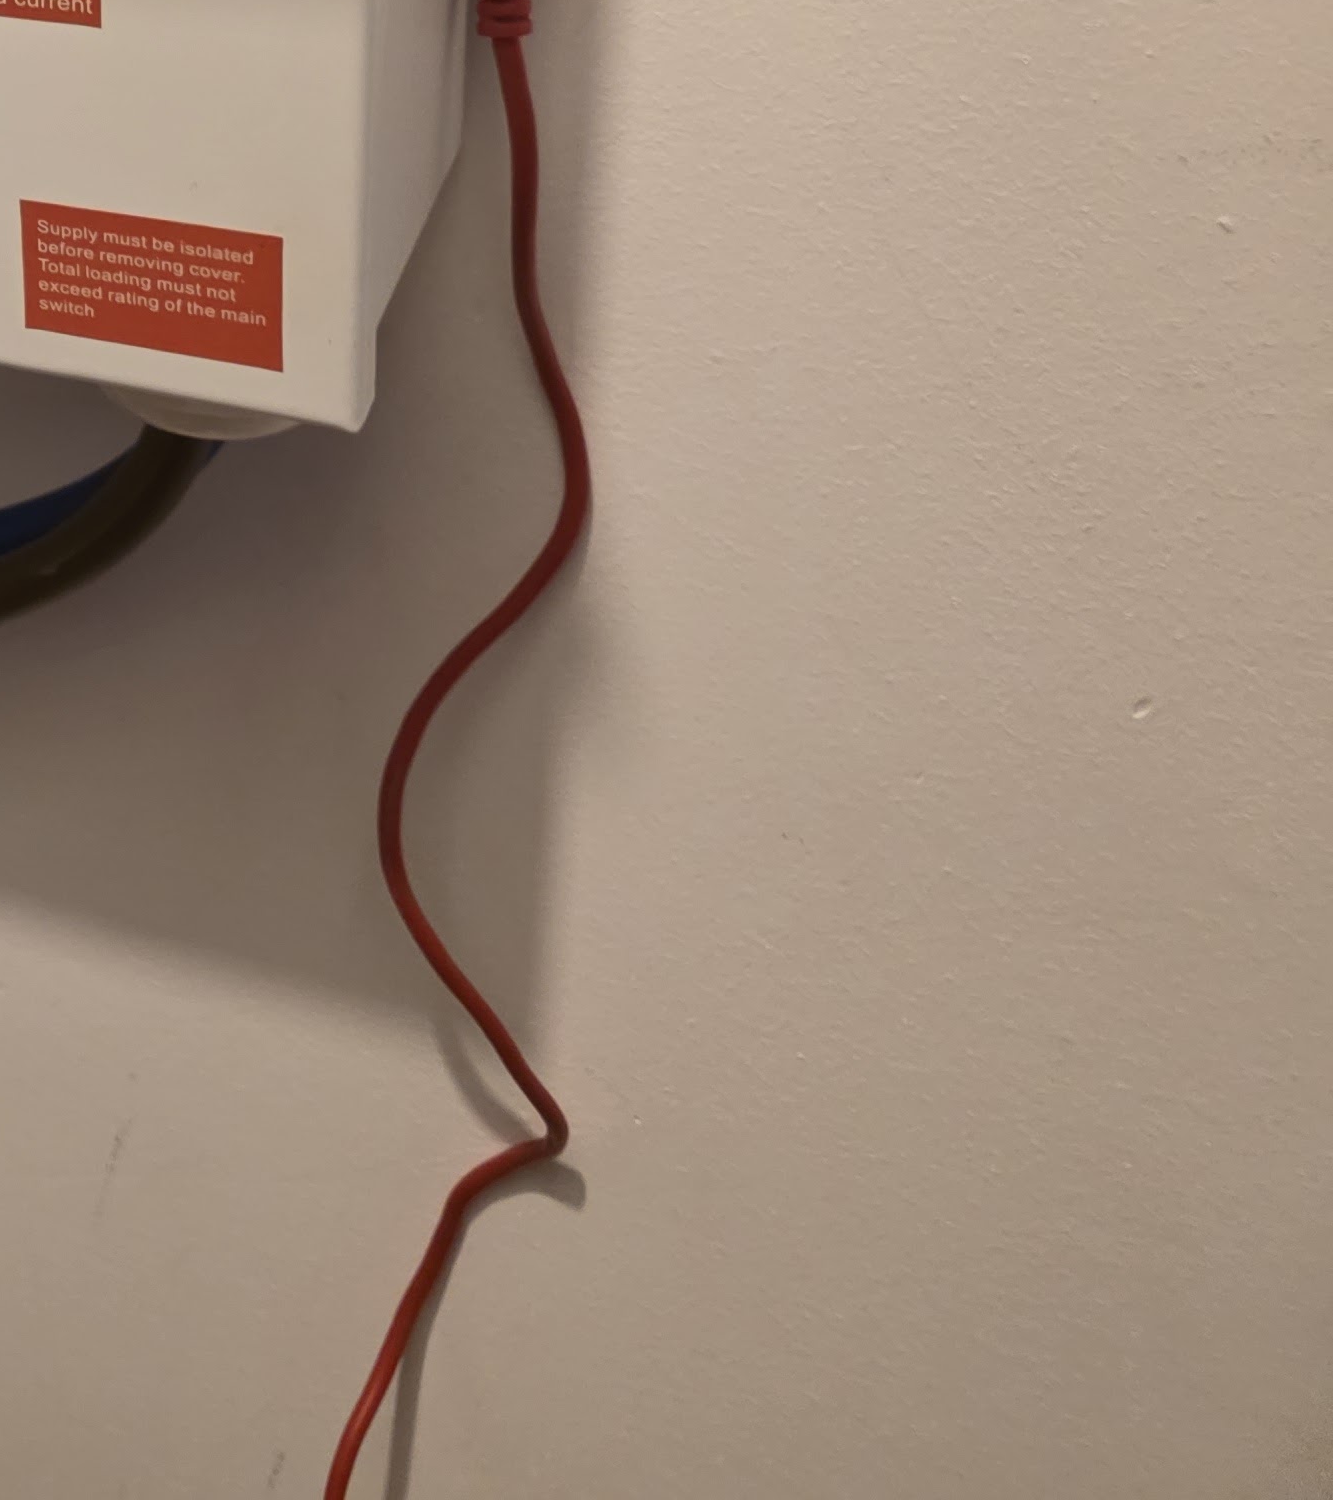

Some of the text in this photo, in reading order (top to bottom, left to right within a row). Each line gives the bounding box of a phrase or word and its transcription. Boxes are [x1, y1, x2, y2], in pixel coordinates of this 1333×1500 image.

[37, 220, 254, 265] Supply must be isolated
[37, 239, 245, 283] before removing cover.
[38, 258, 236, 302] Total loading must not
[39, 280, 266, 327] exceed rating of the main
[39, 299, 95, 318] switch
